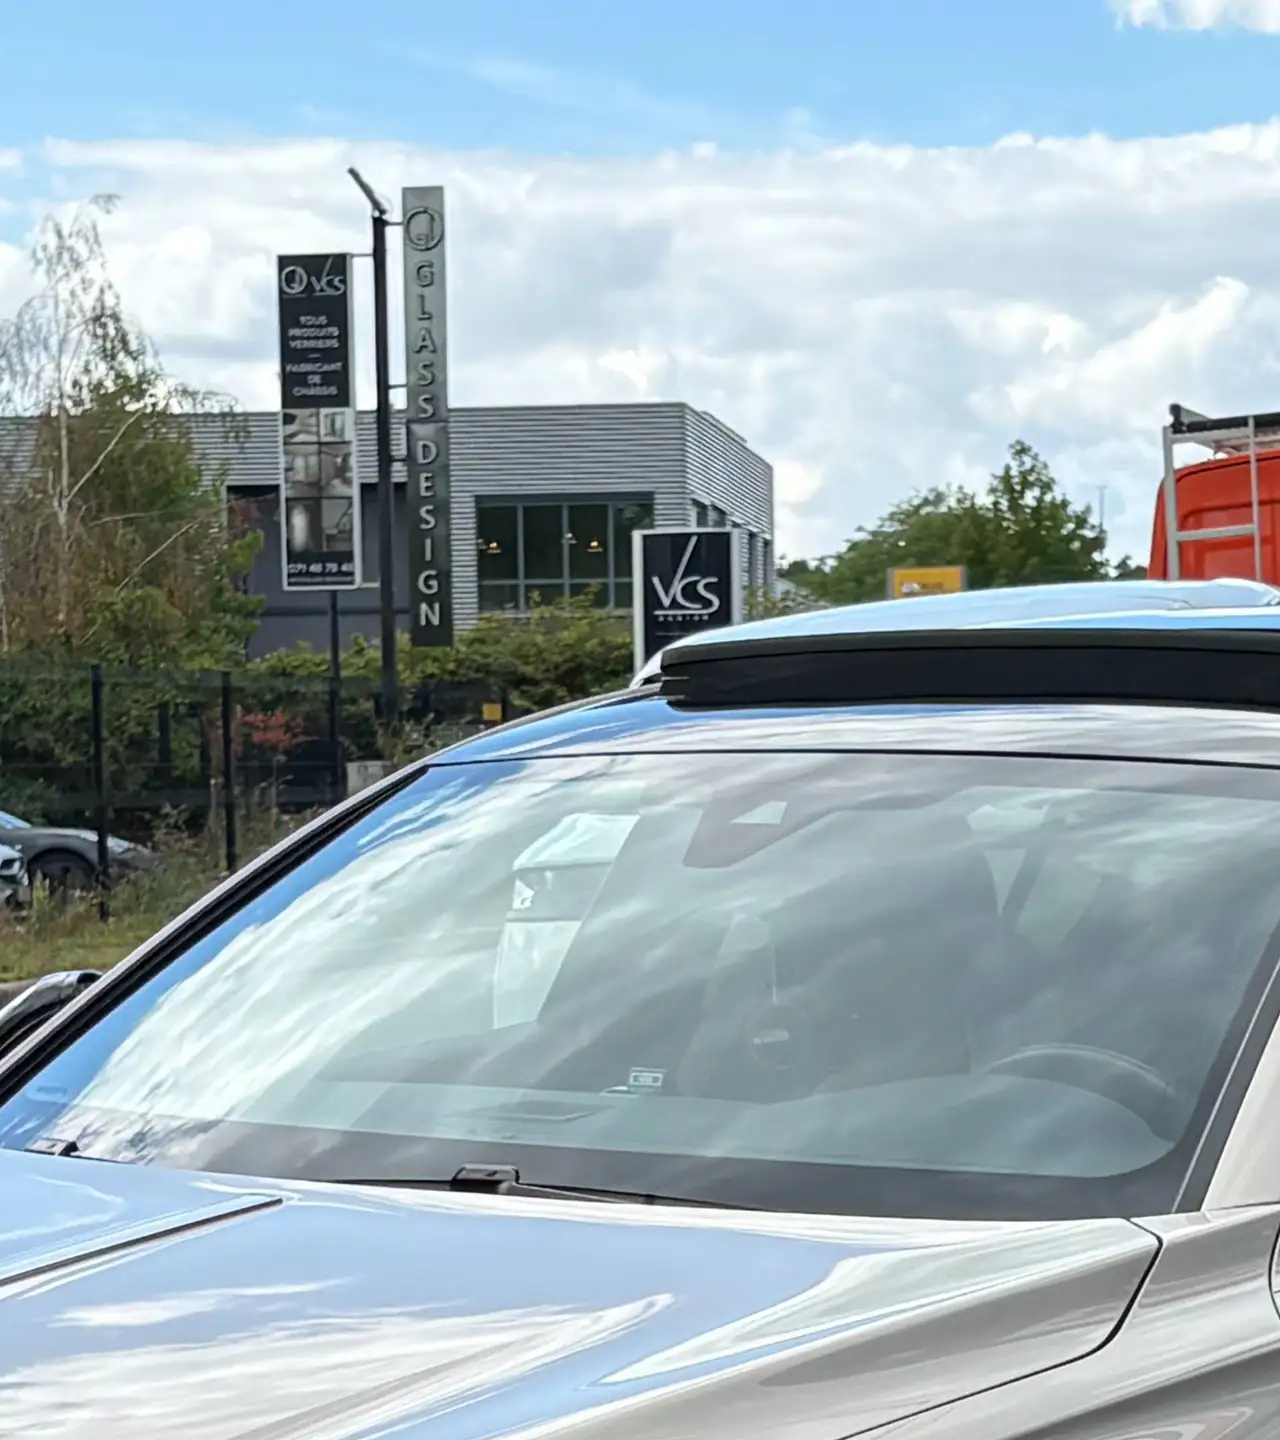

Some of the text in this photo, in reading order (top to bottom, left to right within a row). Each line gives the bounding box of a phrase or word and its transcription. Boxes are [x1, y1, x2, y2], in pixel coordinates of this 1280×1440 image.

[412, 261, 438, 420] GLASS
[417, 440, 440, 627] DESIGN
[651, 534, 720, 616] VCS
